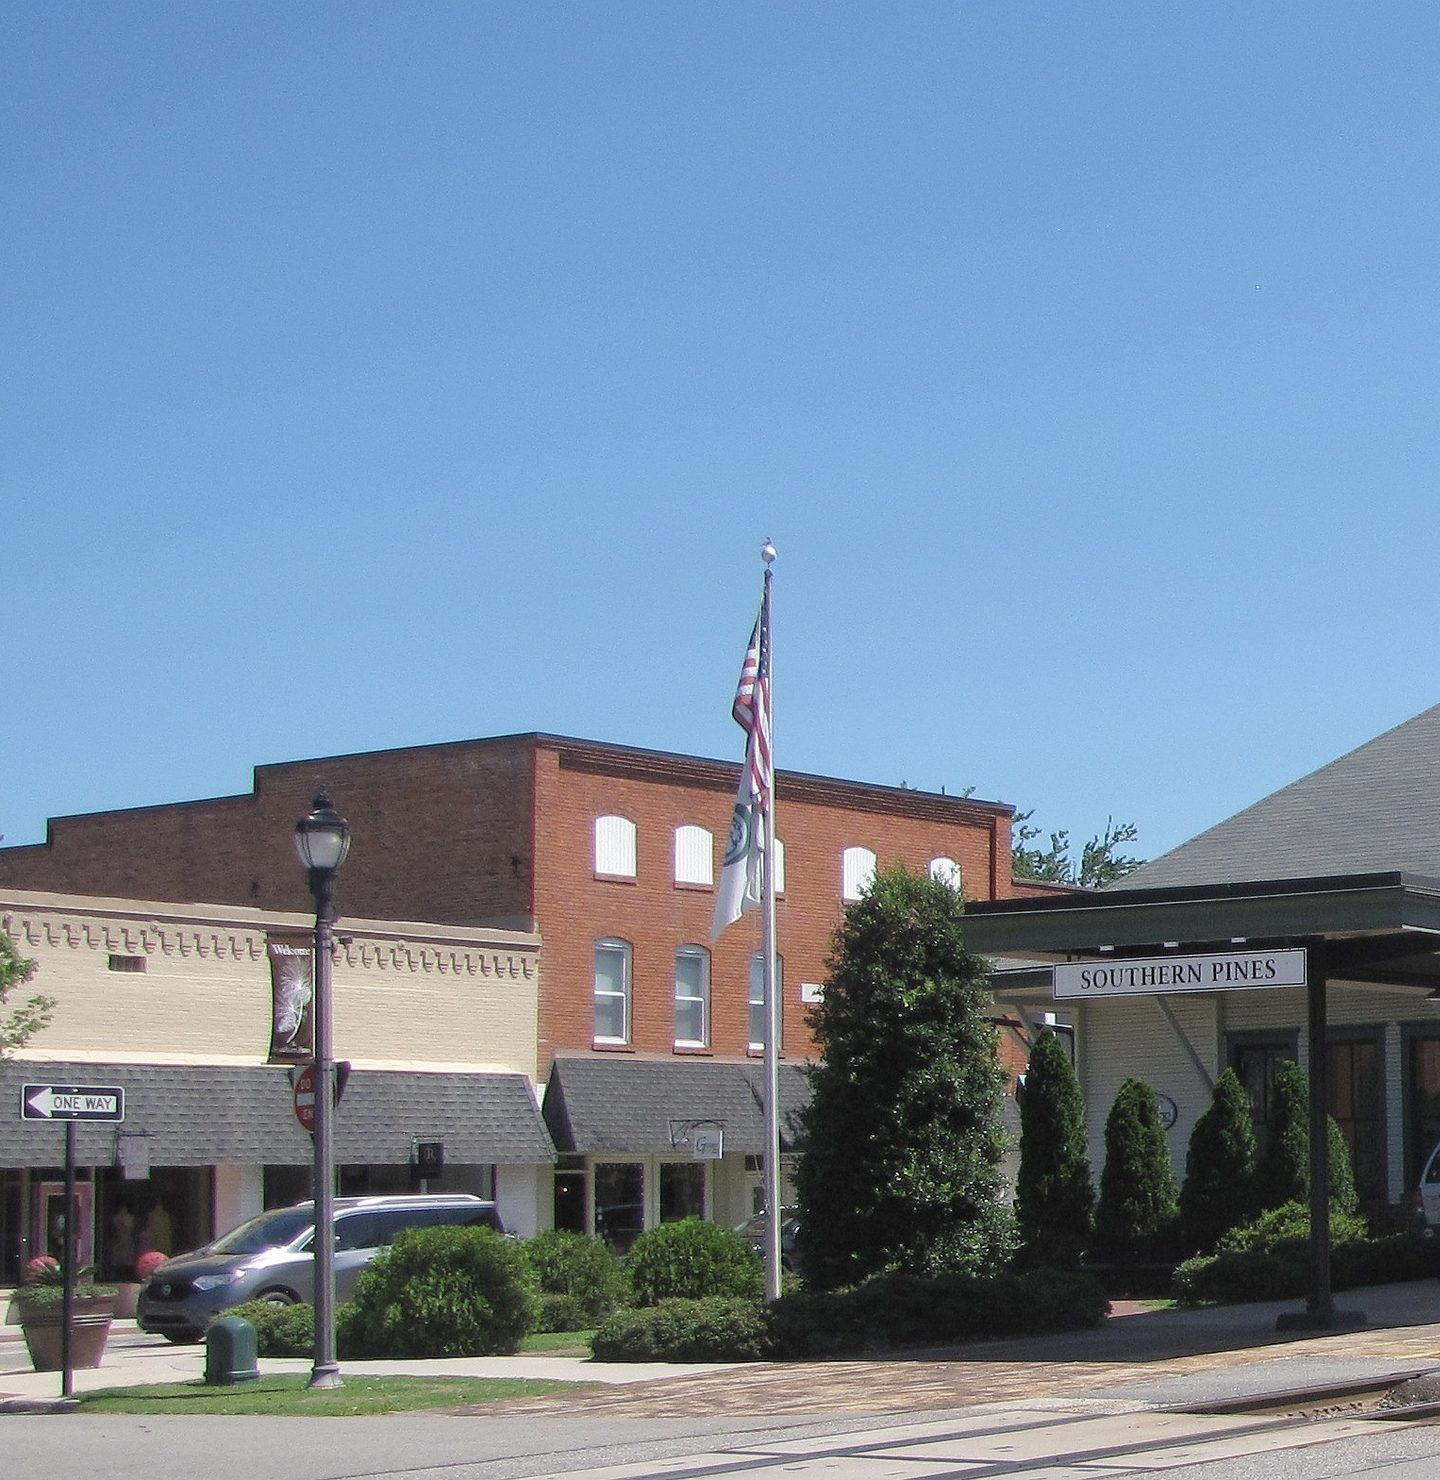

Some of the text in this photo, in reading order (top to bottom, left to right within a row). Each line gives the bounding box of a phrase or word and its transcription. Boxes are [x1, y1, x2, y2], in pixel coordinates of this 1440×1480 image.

[1081, 959, 1277, 990] SOUTHERN PINES
[54, 1096, 113, 1111] ONE WAY
